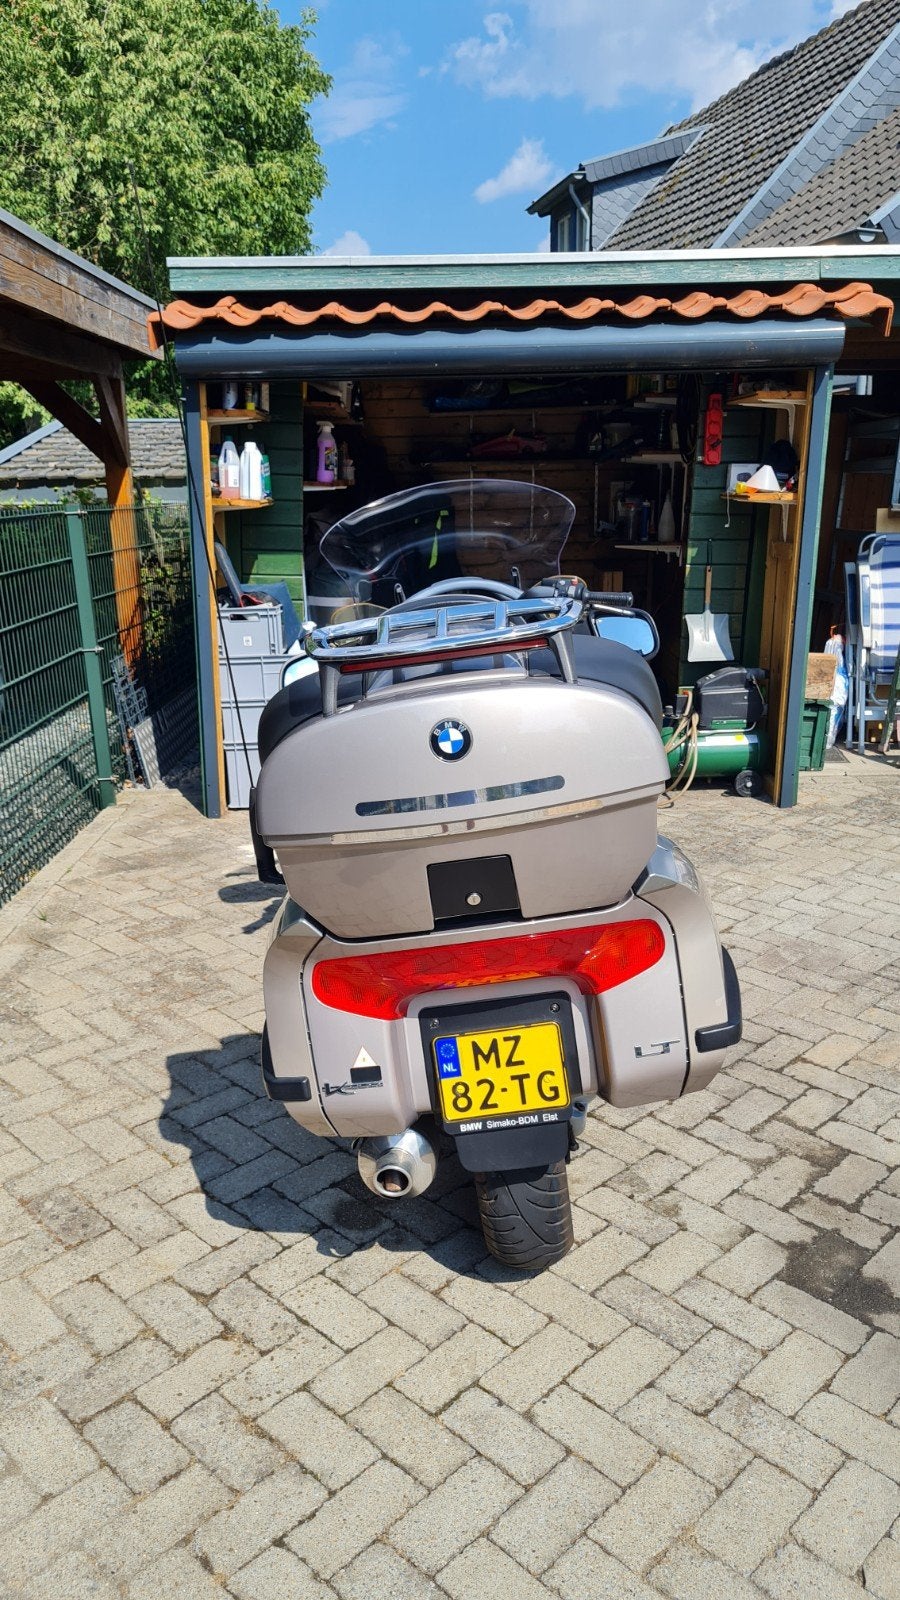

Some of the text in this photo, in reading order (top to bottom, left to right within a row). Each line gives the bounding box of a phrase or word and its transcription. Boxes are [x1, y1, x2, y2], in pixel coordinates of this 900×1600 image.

[434, 721, 467, 736] BMW
[471, 1035, 525, 1071] MZ
[443, 1062, 457, 1073] NL
[452, 1070, 560, 1113] 82-TG
[460, 1113, 559, 1133] BMW Simako-BDM Elst
